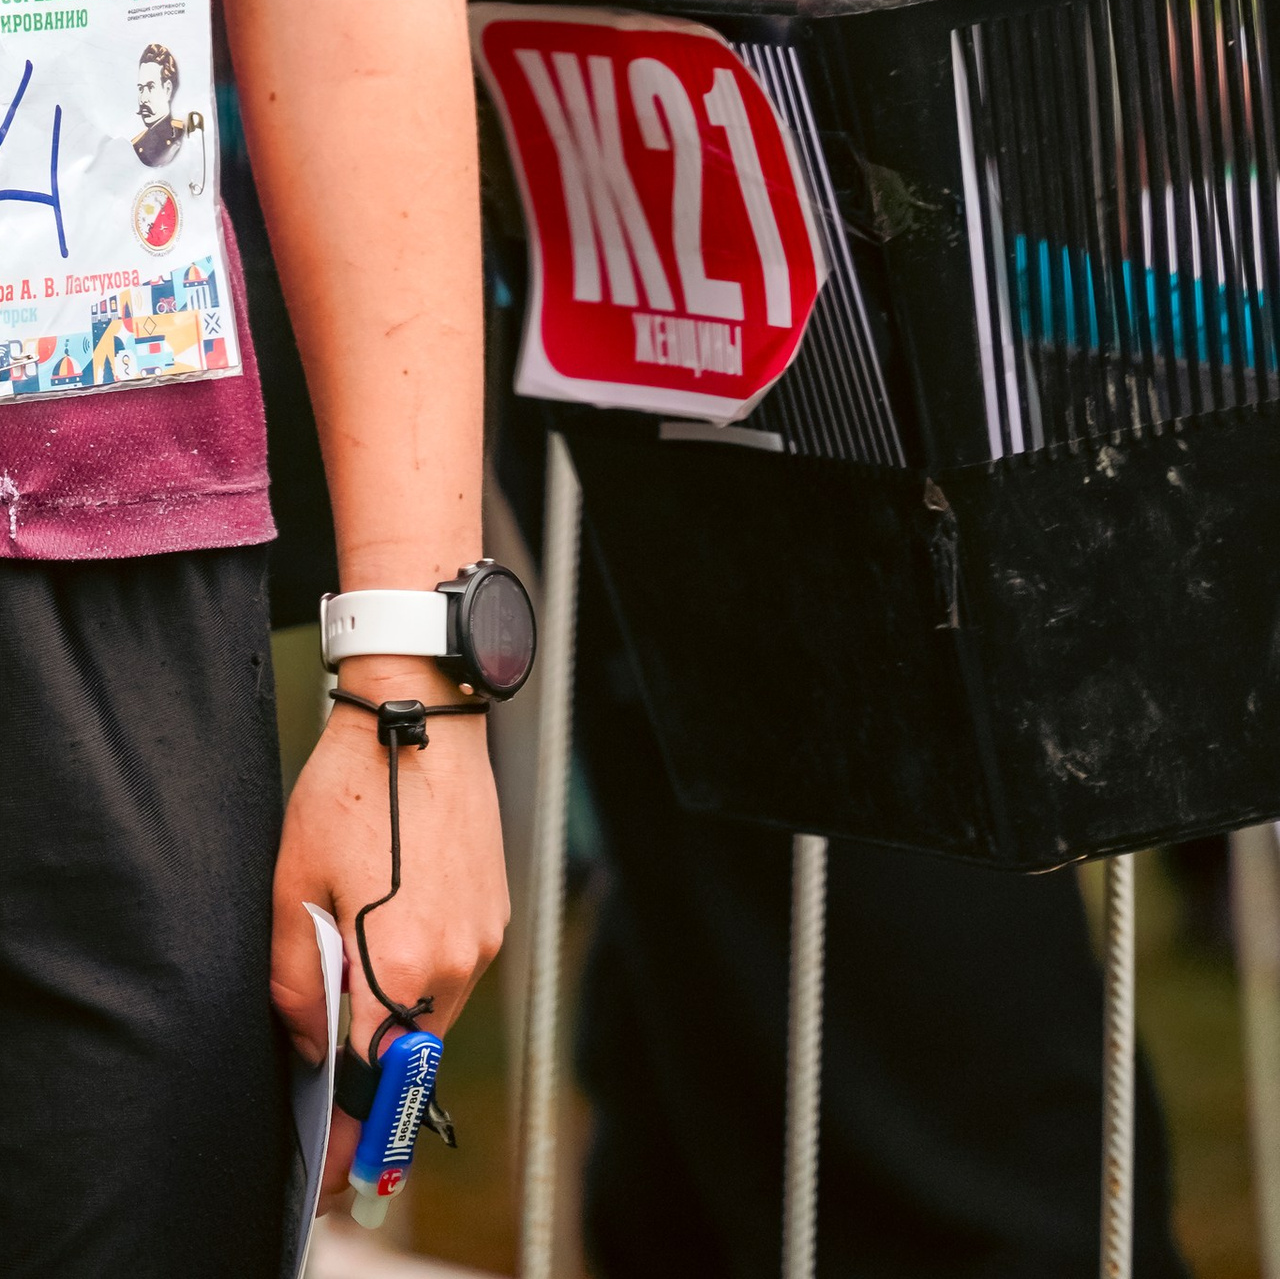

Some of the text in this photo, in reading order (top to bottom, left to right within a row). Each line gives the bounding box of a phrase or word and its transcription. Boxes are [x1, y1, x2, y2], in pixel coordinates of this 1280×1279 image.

[514, 48, 792, 329] Ж21
[20, 279, 36, 300] А.
[44, 277, 59, 298] В.
[65, 269, 140, 295] Пастухова
[397, 1088, 421, 1142] 8654780
